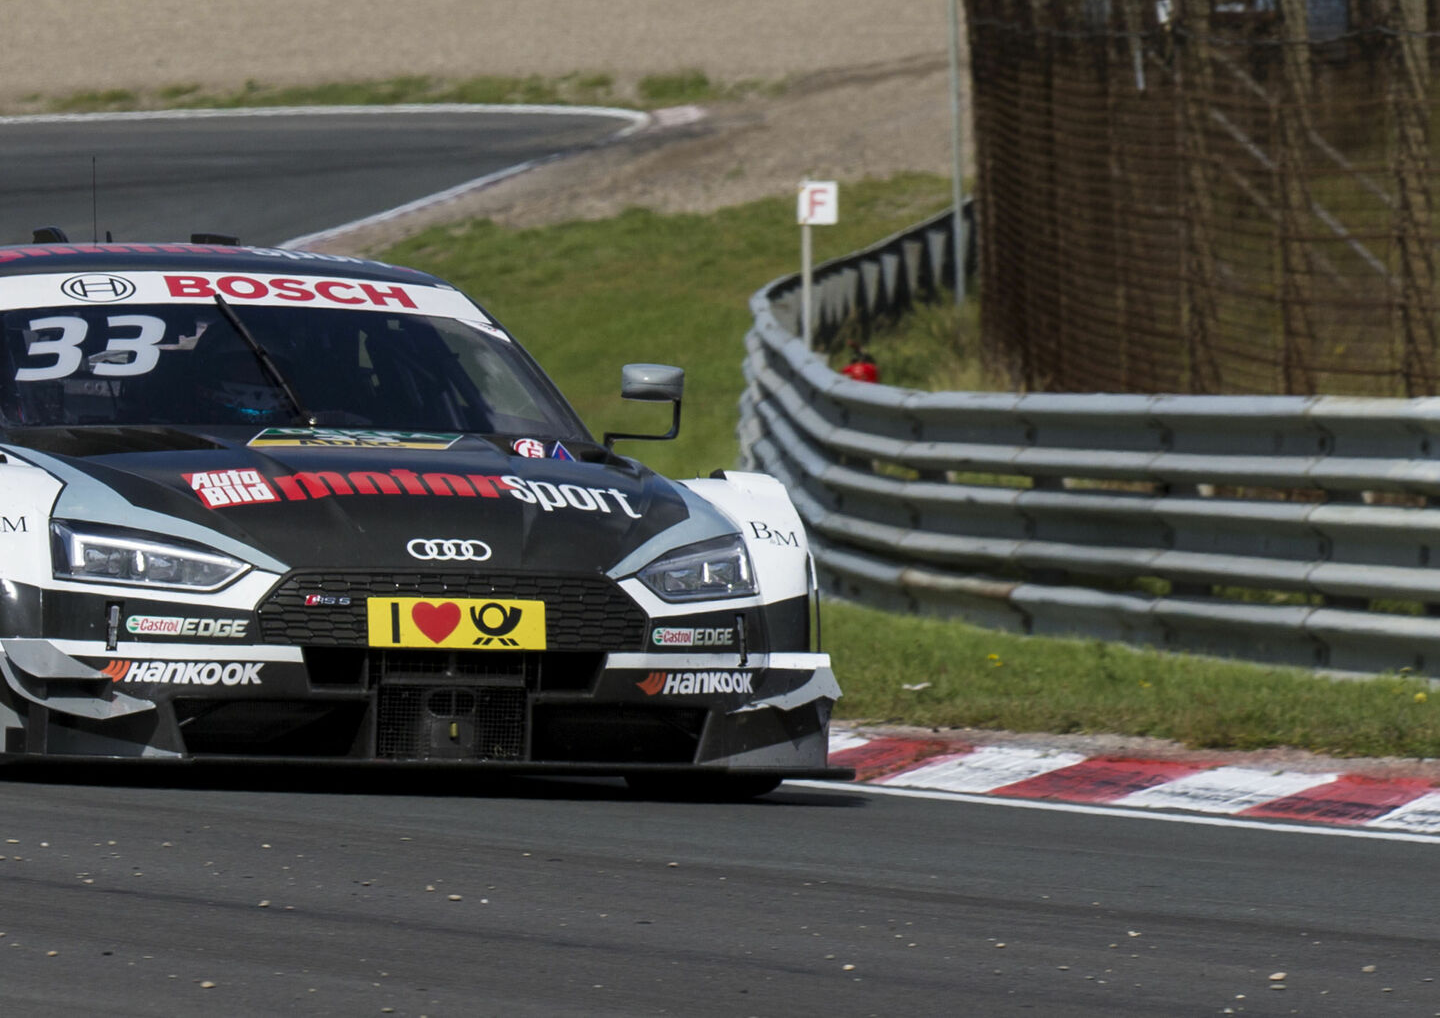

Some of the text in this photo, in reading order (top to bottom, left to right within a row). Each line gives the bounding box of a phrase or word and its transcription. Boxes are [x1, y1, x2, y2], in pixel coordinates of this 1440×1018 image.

[808, 188, 828, 219] F
[163, 275, 419, 309] BOSCH
[14, 314, 167, 382] 33
[191, 470, 262, 490] Auto
[201, 483, 276, 507] Bild
[140, 617, 250, 638] Castrol EDGE
[391, 602, 400, 644] I
[663, 628, 735, 645] Castrol EDGE
